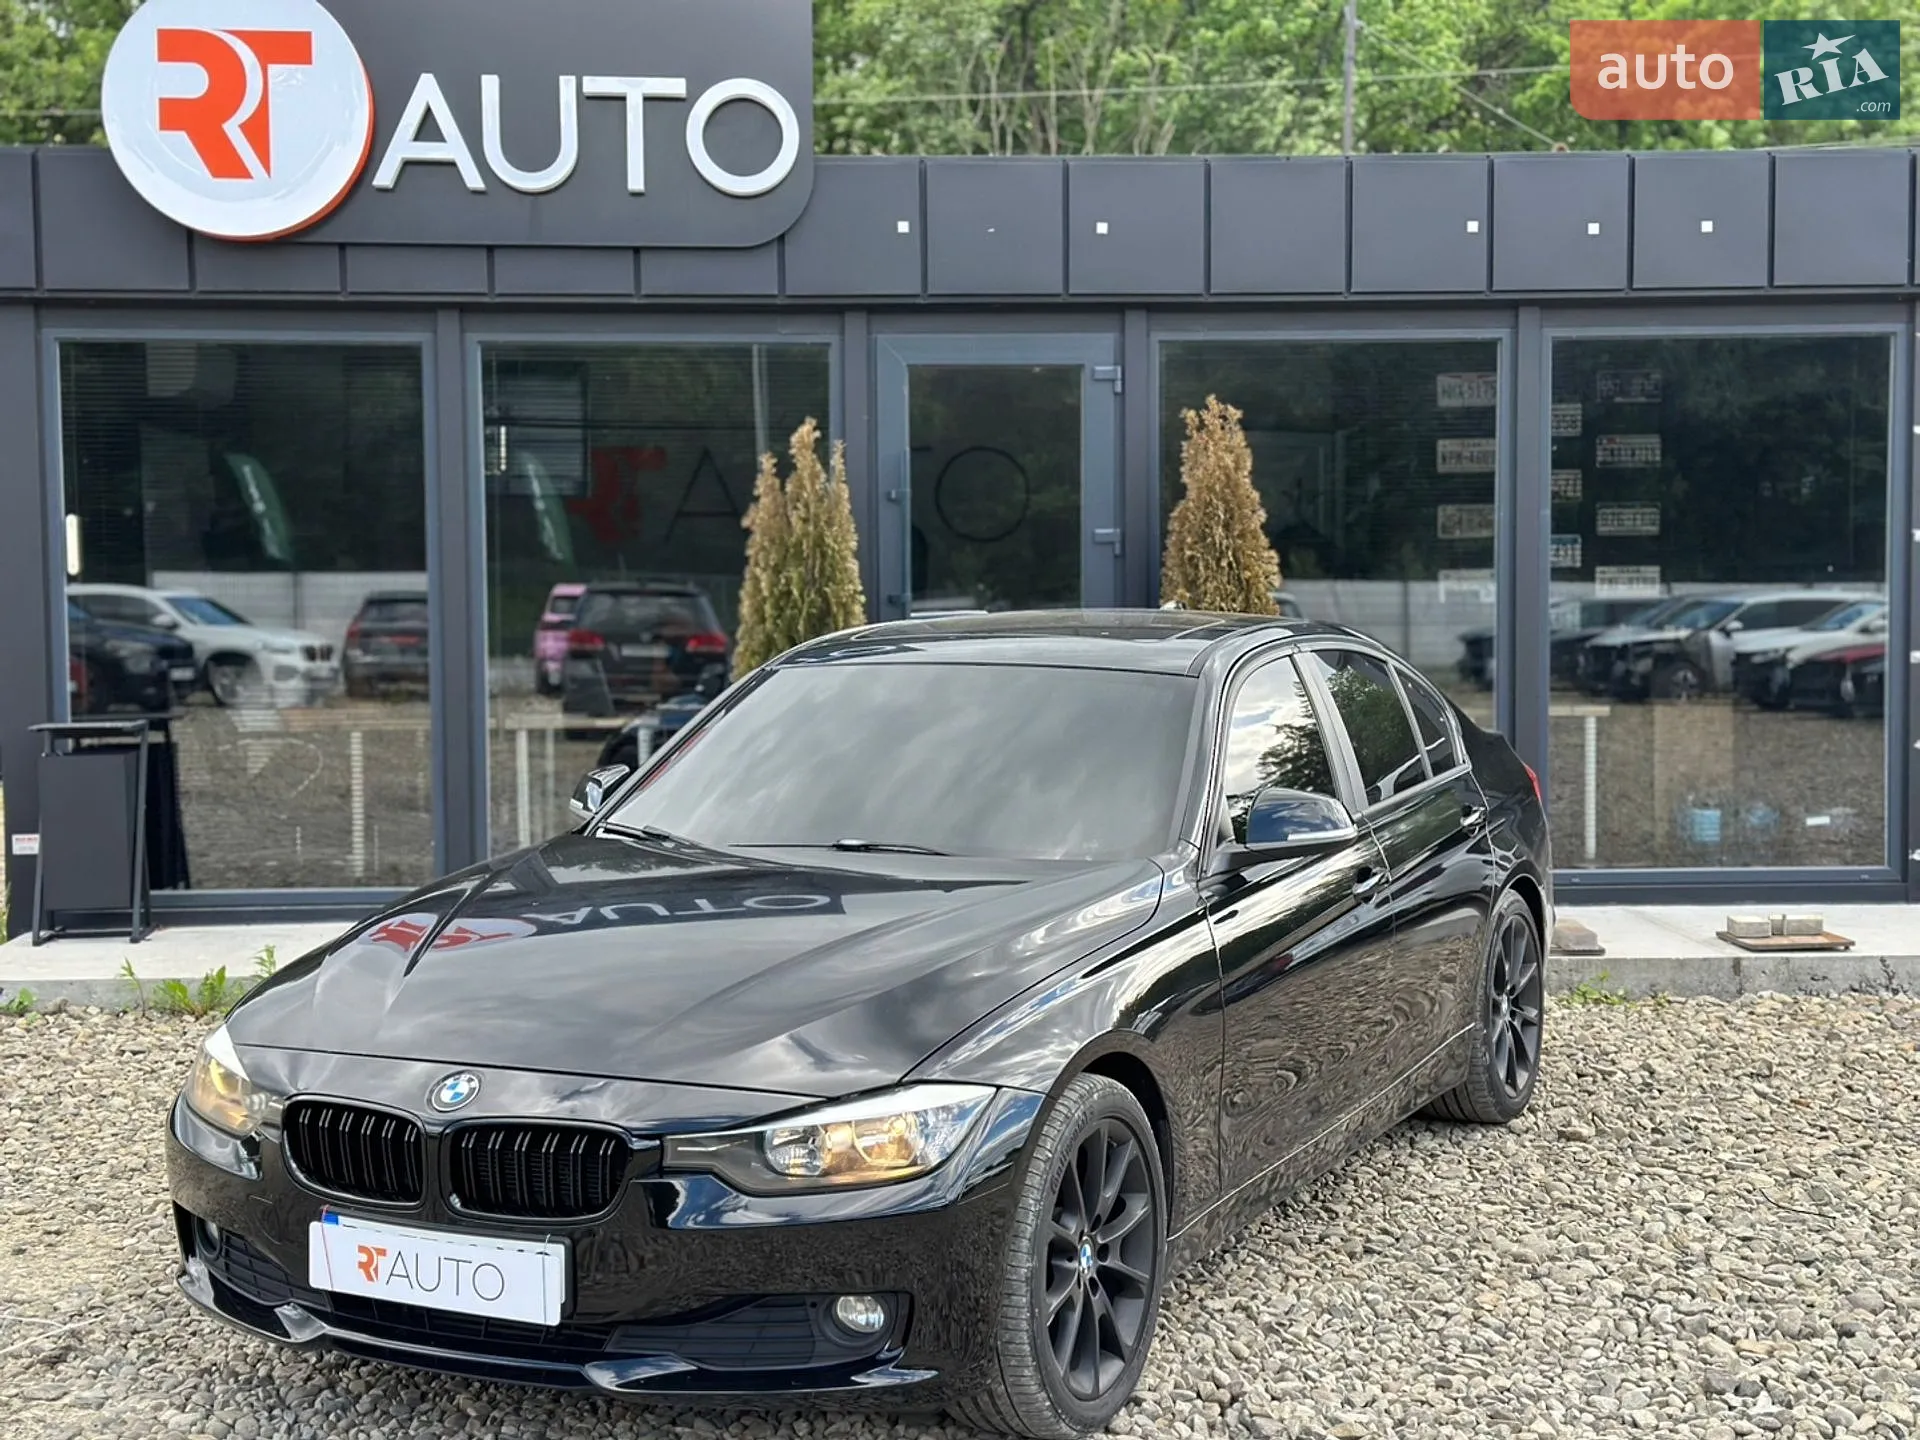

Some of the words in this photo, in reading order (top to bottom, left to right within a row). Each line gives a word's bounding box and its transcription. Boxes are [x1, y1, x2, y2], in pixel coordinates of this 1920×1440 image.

[156, 28, 313, 179] RT
[371, 72, 801, 196] AUTO
[357, 1244, 387, 1283] RT
[385, 1250, 505, 1301] AUTO
